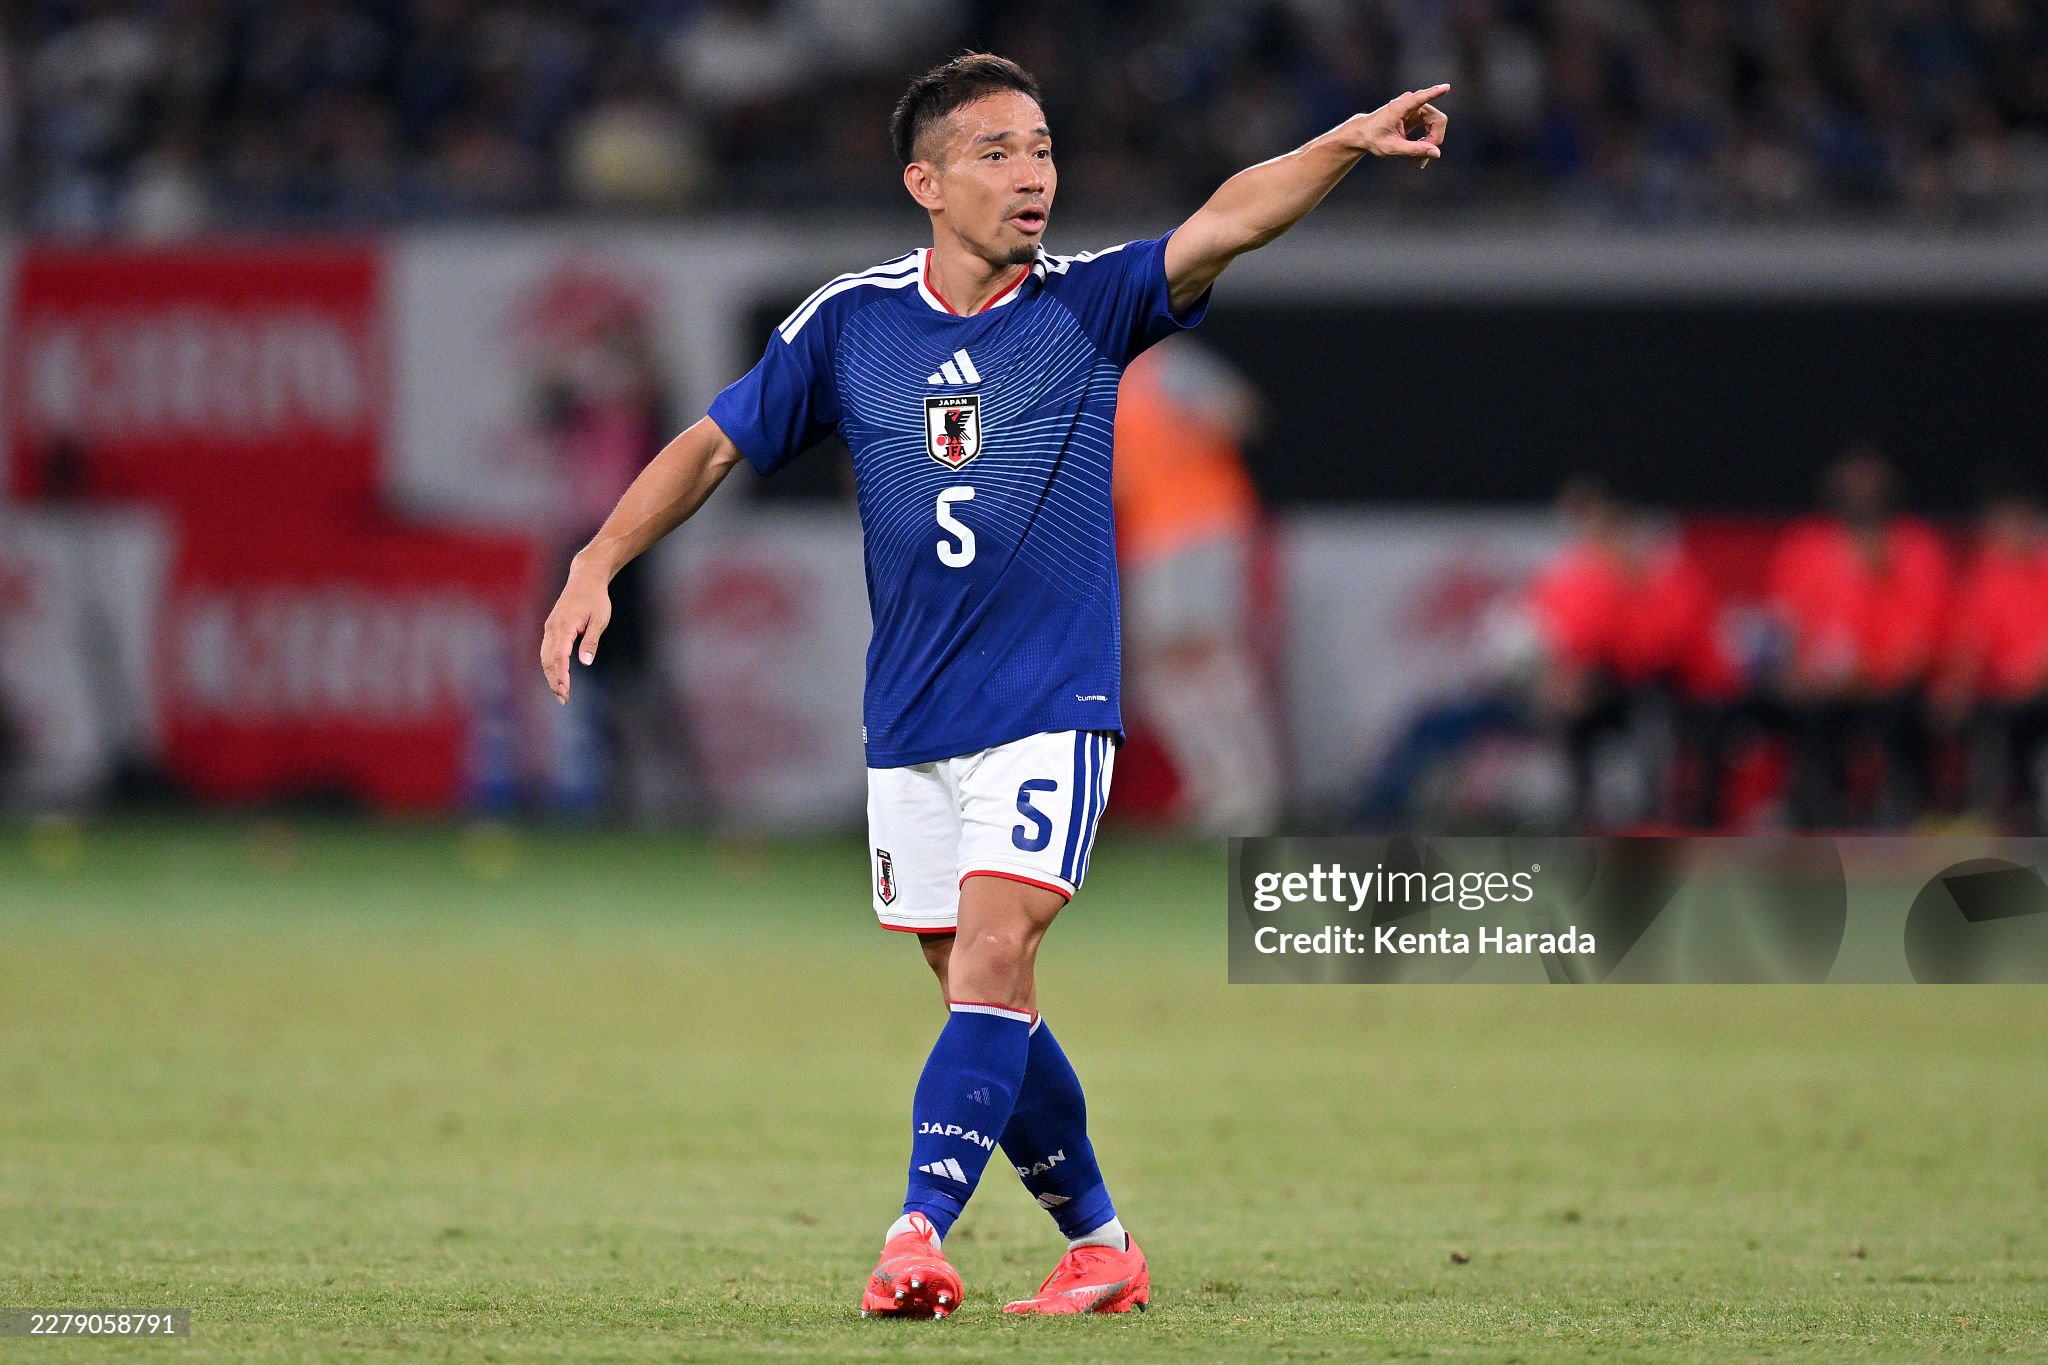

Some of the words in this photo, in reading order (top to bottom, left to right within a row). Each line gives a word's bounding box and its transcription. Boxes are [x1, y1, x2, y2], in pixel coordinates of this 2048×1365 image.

[938, 398, 968, 407] JAPAN
[943, 445, 967, 457] JFA
[936, 486, 976, 568] 5
[1011, 778, 1058, 852] 5
[918, 1122, 994, 1151] JAPAN
[1016, 1149, 1066, 1178] PAN
